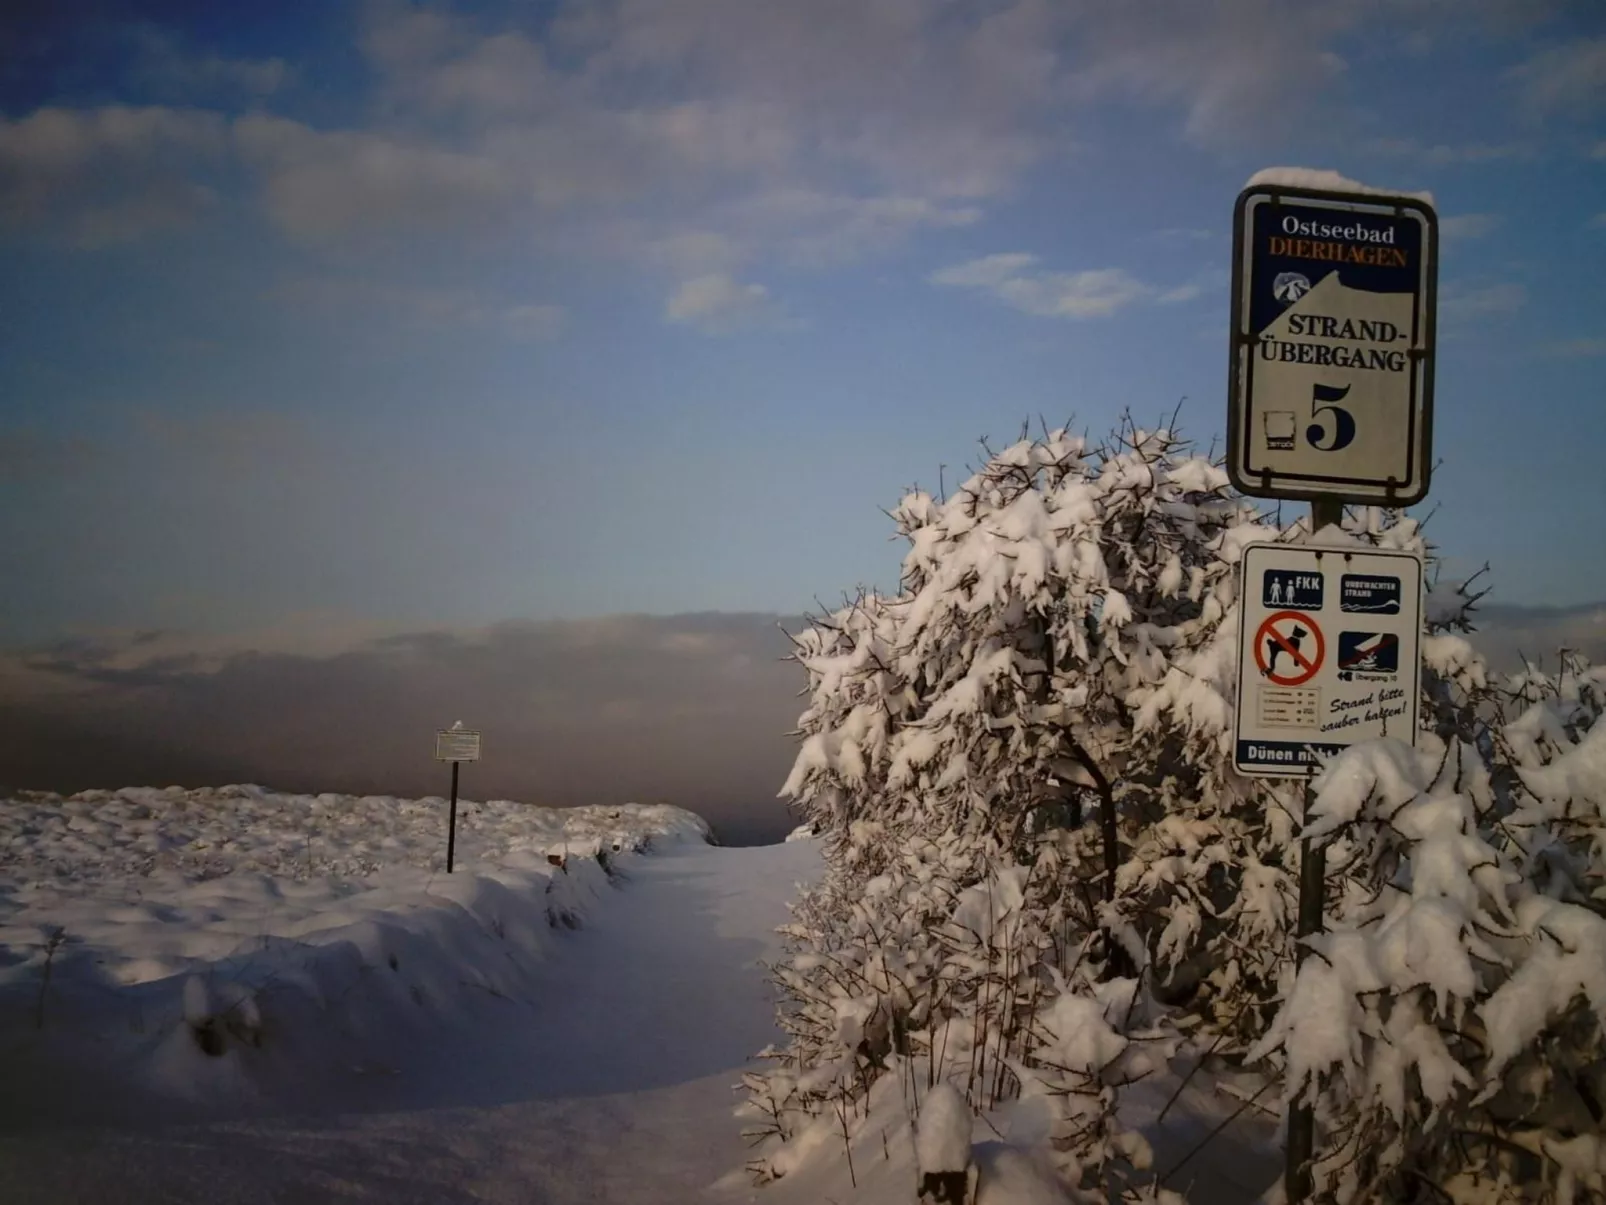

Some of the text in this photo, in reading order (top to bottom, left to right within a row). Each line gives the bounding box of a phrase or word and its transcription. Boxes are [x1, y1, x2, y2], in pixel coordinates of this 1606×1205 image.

[1282, 216, 1395, 244] Ostseebad
[1269, 236, 1408, 267] DIERHAGEN
[1288, 313, 1408, 343] STRAND-
[1260, 335, 1406, 372] ÜBERGANG
[1306, 383, 1356, 451] 5
[1295, 576, 1320, 590] FKK
[1330, 688, 1405, 713] Strand bitte
[1320, 713, 1360, 733] sauber
[1248, 745, 1294, 761] Dünen
